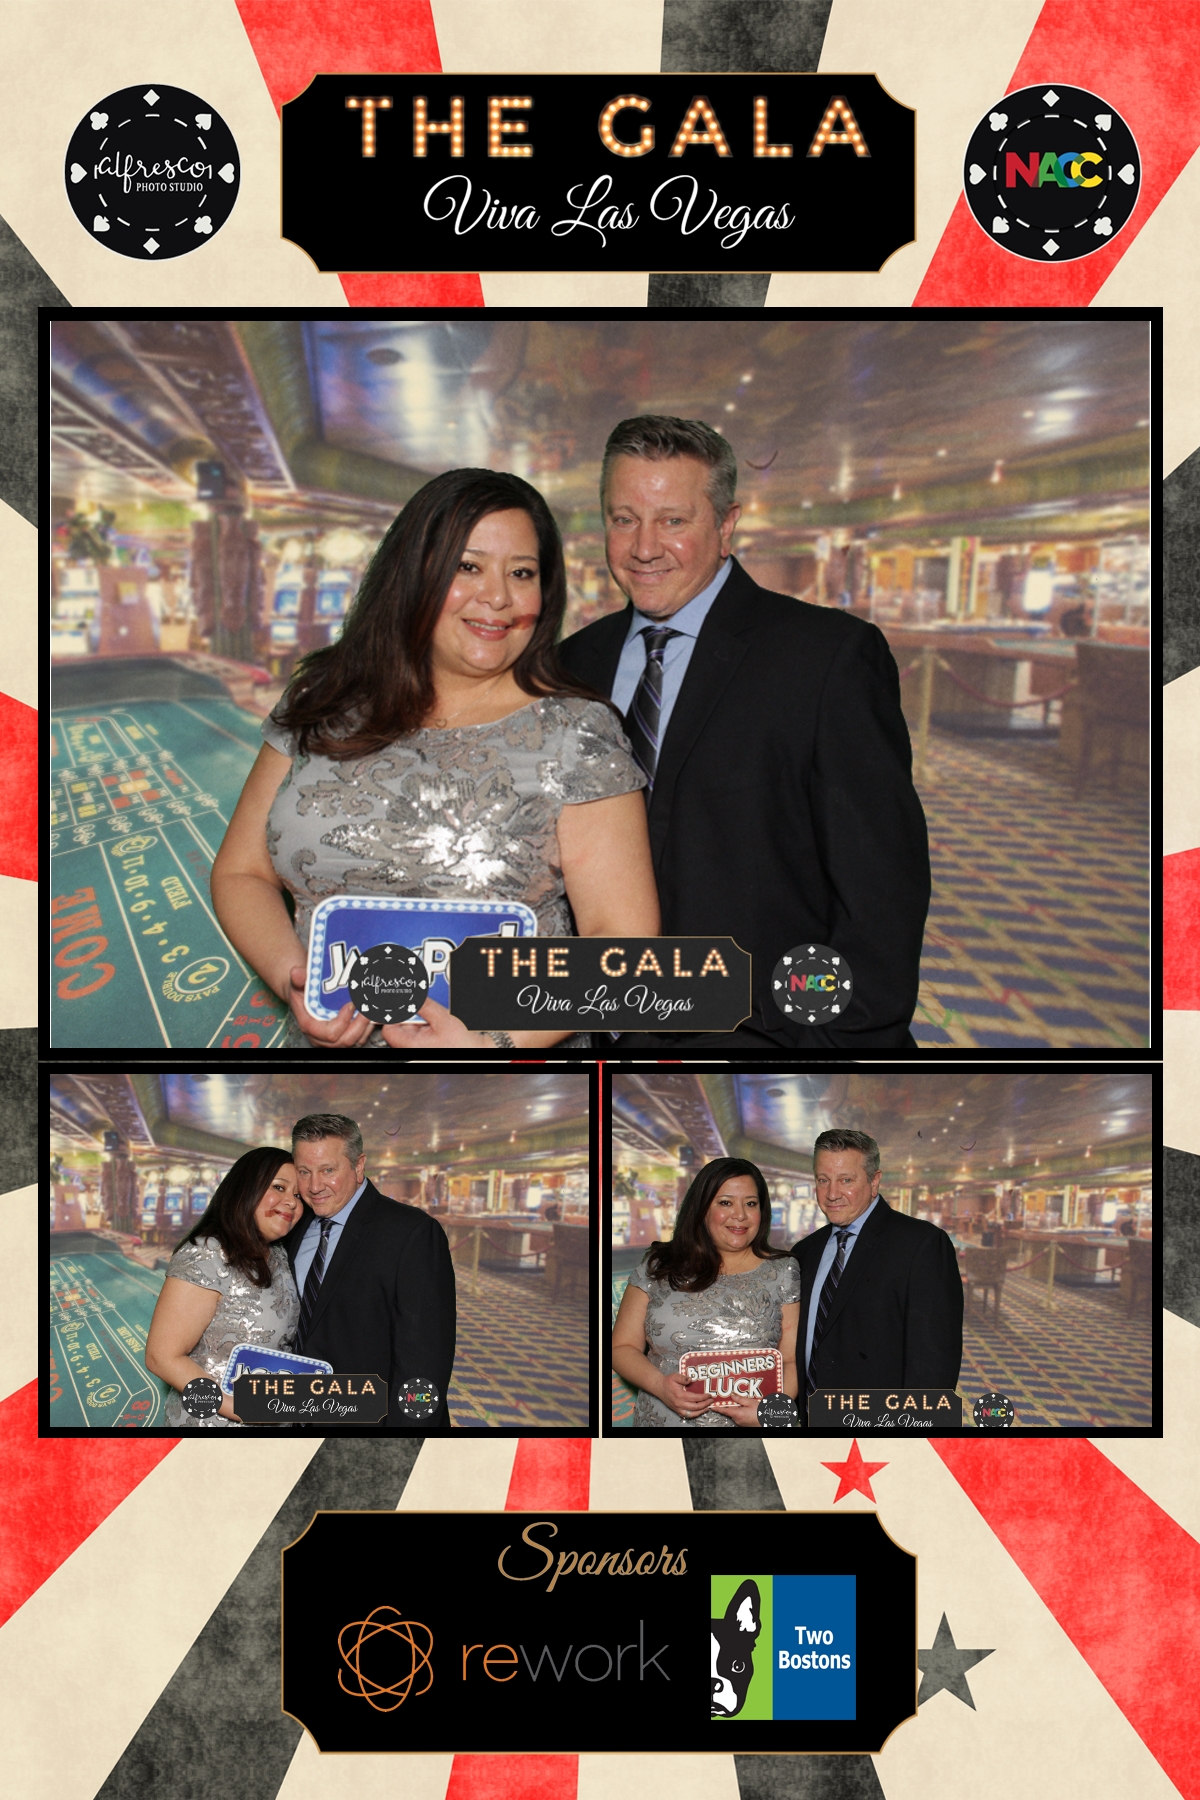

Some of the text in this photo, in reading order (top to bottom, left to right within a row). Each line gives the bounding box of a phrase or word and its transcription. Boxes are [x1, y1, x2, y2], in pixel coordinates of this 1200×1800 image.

[160, 876, 193, 911] FIELD
[51, 886, 116, 1000] COME
[686, 1354, 775, 1382] BEGINNERS
[704, 1377, 763, 1399] LUCK
